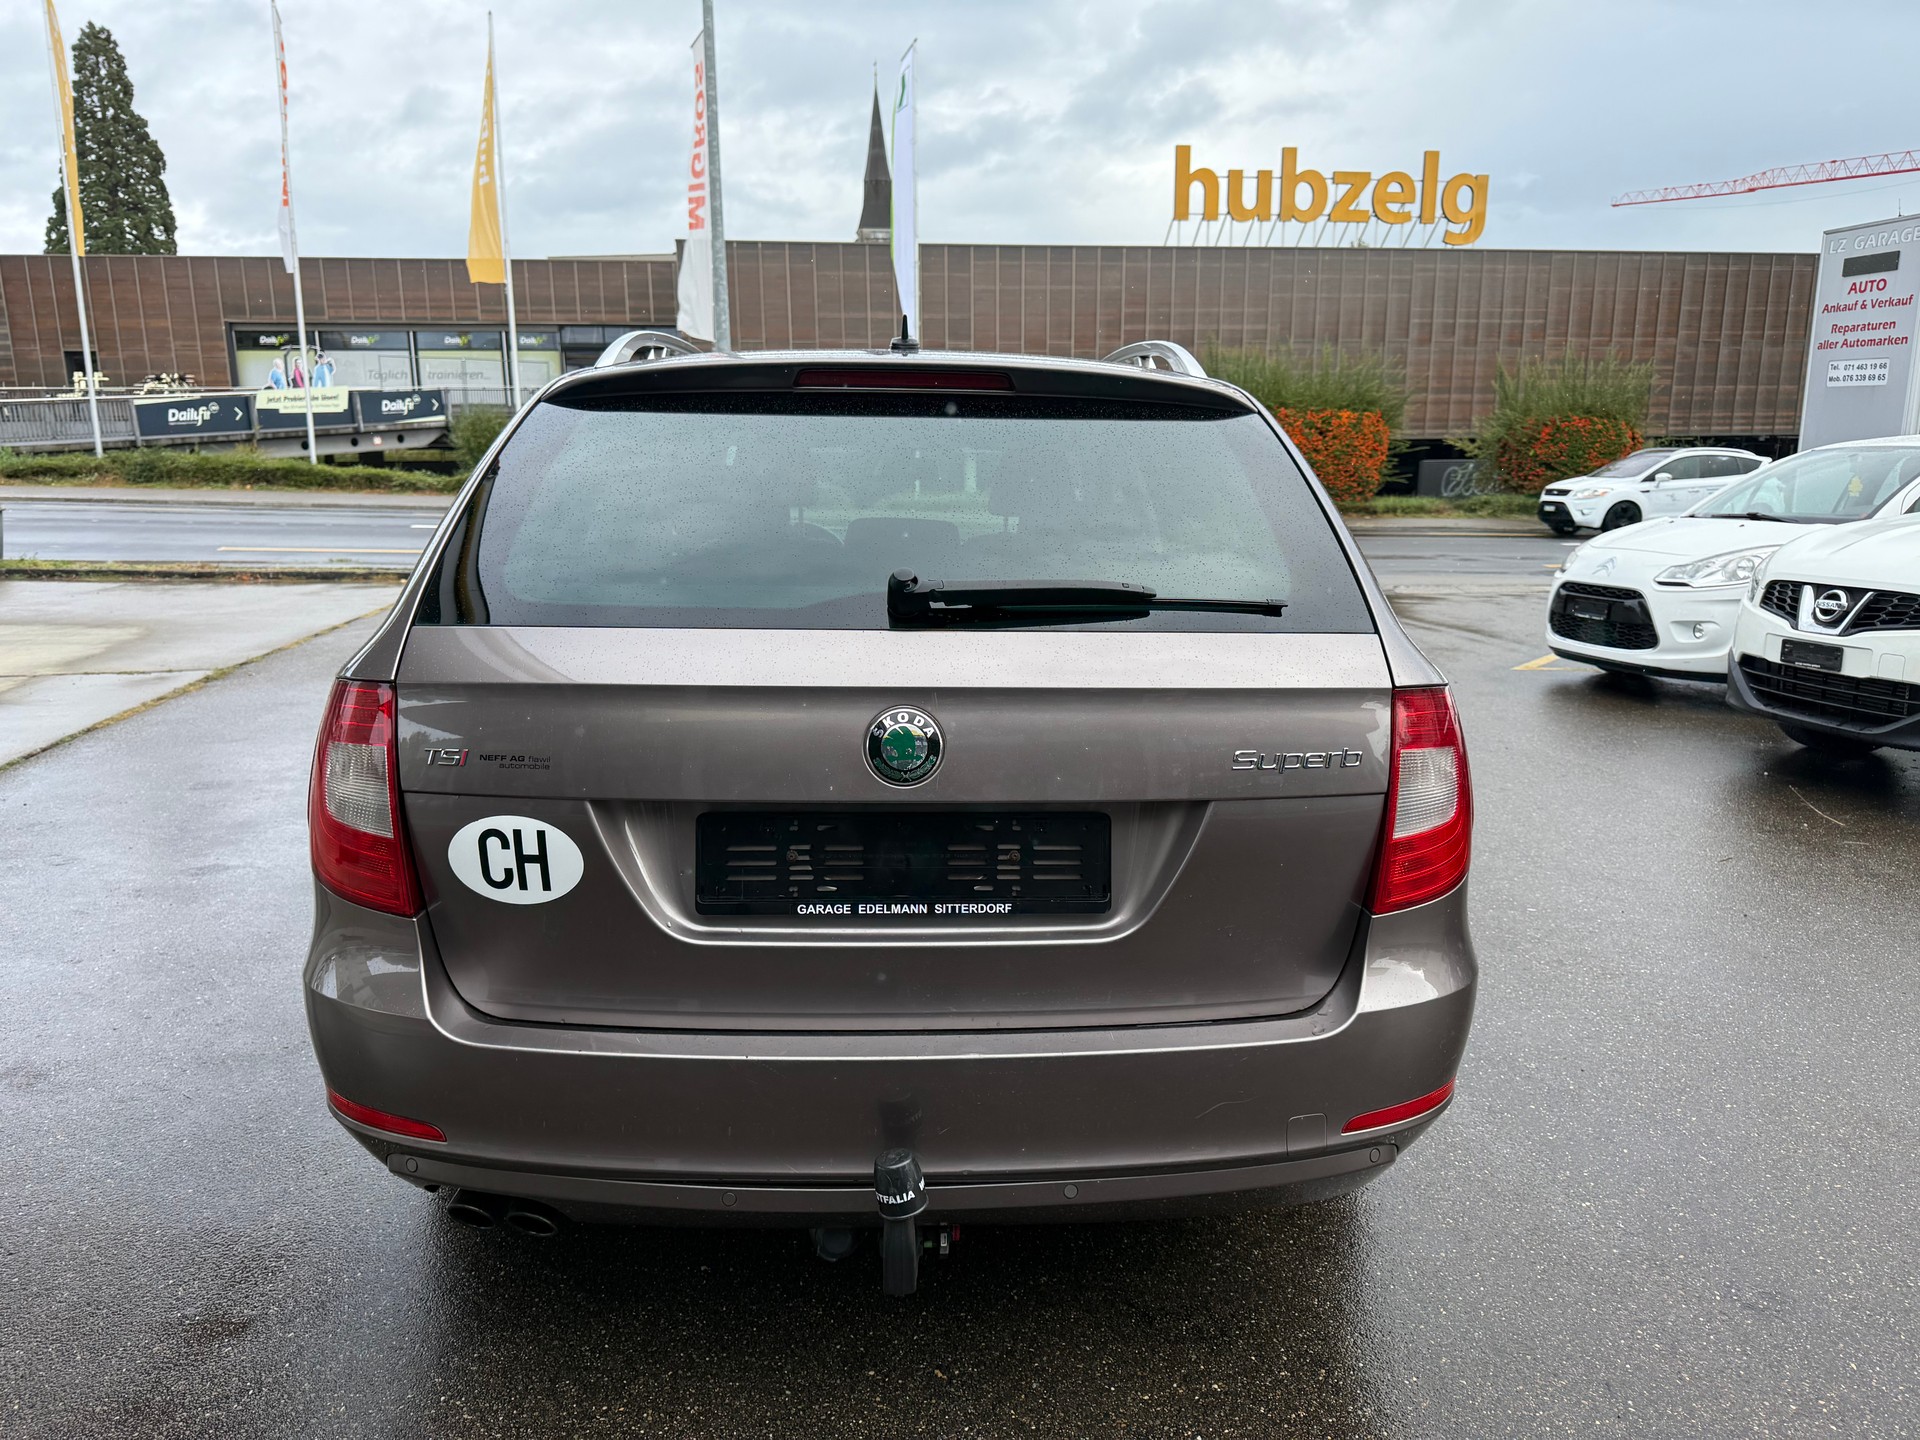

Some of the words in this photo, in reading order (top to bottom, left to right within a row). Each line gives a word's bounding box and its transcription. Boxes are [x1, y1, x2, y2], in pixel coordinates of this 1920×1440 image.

[1174, 145, 1489, 245] hubzelg
[1829, 238, 1847, 254] LZ
[1854, 226, 1920, 250] GARAGE
[1847, 278, 1887, 295] AUTO
[1822, 301, 1859, 314] Ankauf
[1860, 300, 1868, 310] &
[1871, 294, 1914, 309] Verkauf
[1831, 321, 1896, 336] Reparaturen
[1817, 340, 1839, 350] aller
[1841, 336, 1908, 349] Automarken
[425, 748, 468, 766] TSI
[480, 754, 507, 762] NEFF
[1232, 747, 1363, 774] Superb
[478, 828, 551, 891] CH
[797, 904, 851, 915] GARAGE
[858, 904, 928, 914] EDELMANN
[934, 903, 1012, 914] SITTERDORF
